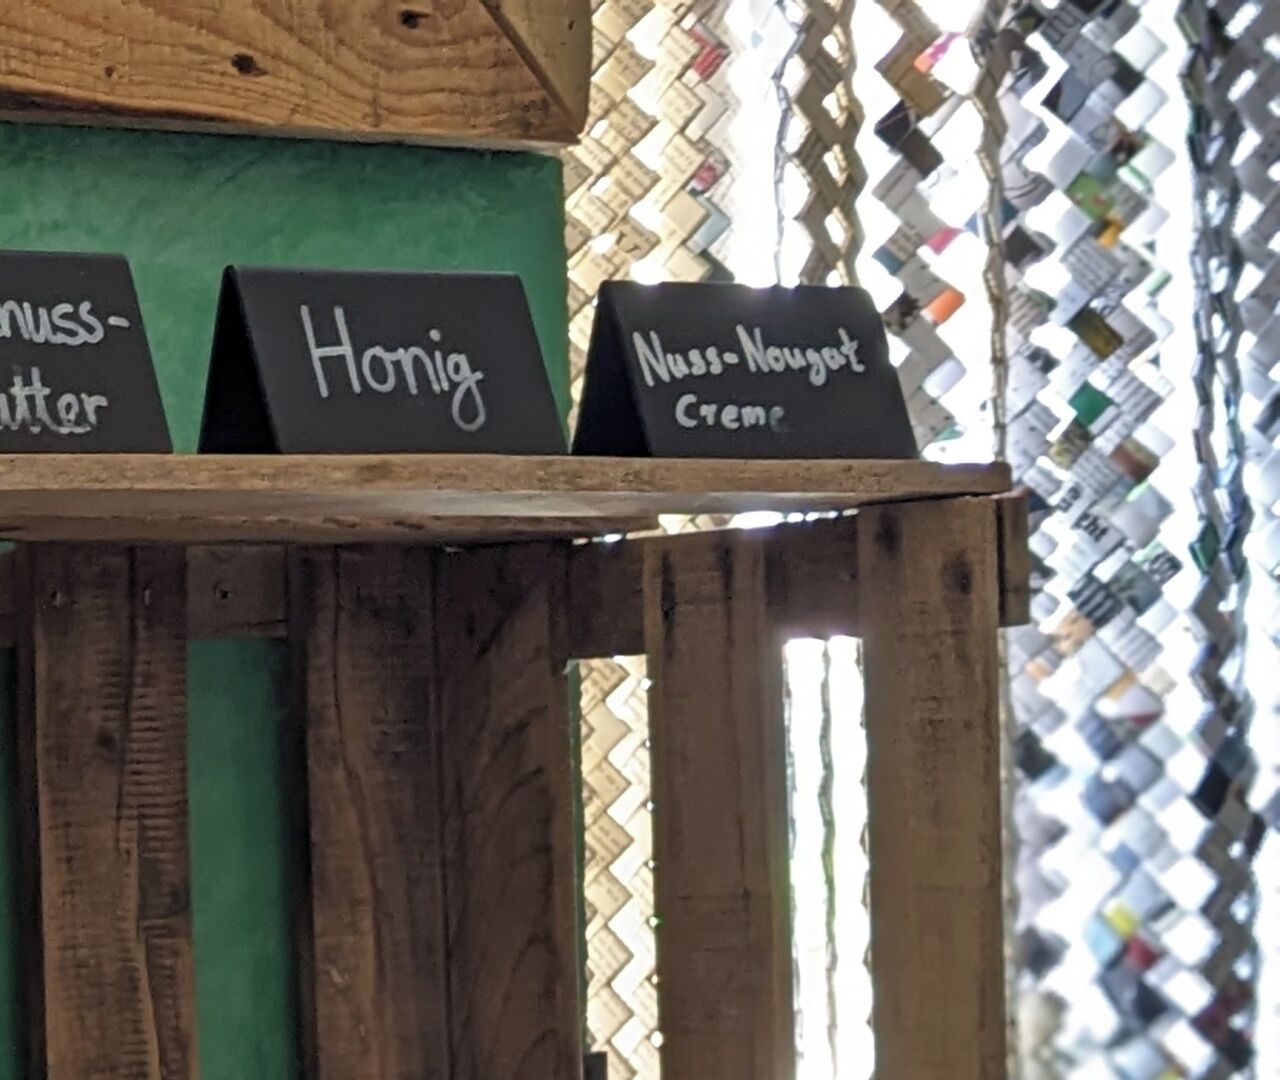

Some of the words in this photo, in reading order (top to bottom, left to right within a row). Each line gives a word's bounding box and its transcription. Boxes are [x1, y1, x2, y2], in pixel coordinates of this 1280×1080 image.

[301, 305, 484, 431] Honig
[632, 324, 865, 387] Nuss-Nougat
[675, 394, 787, 431] Creme
